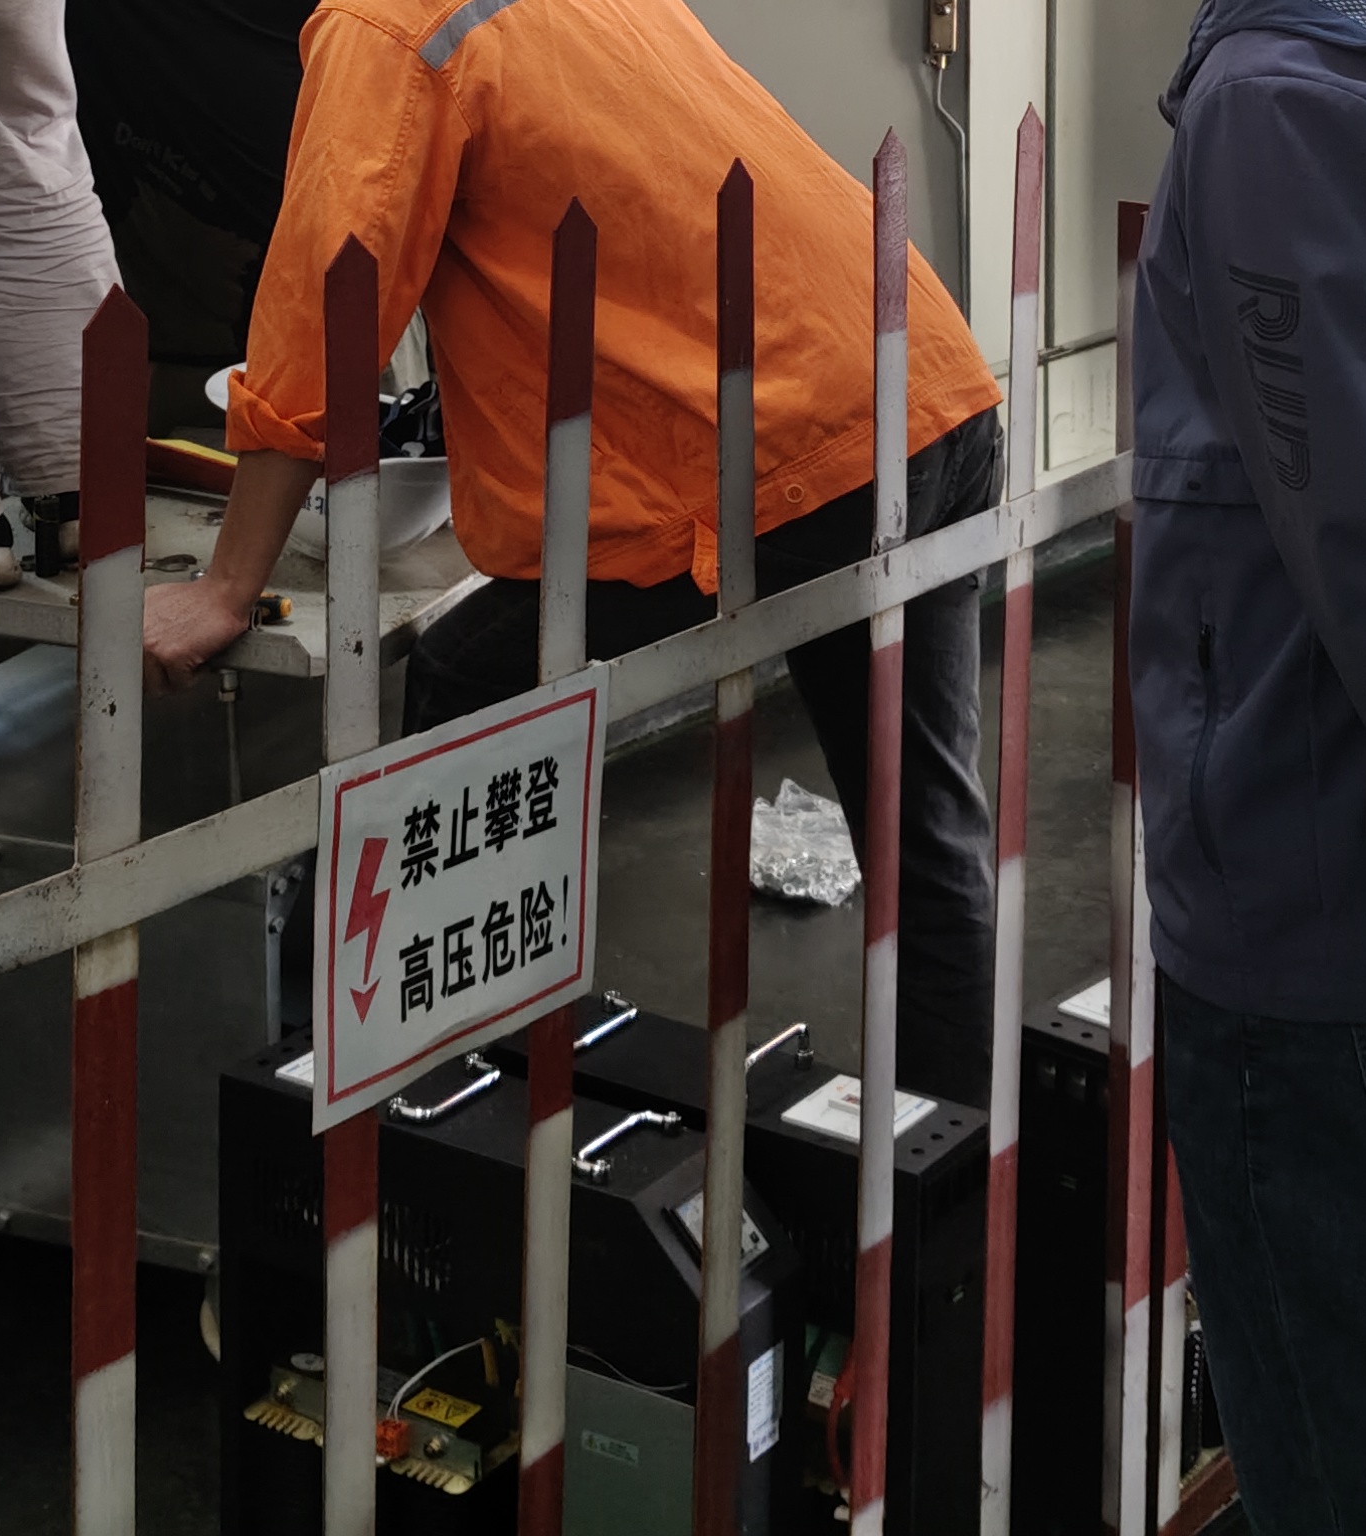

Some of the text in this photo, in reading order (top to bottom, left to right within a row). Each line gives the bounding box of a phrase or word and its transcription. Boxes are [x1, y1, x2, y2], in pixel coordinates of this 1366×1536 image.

[398, 754, 561, 891] 禁止攀登
[398, 873, 570, 1024] 高压危险!
